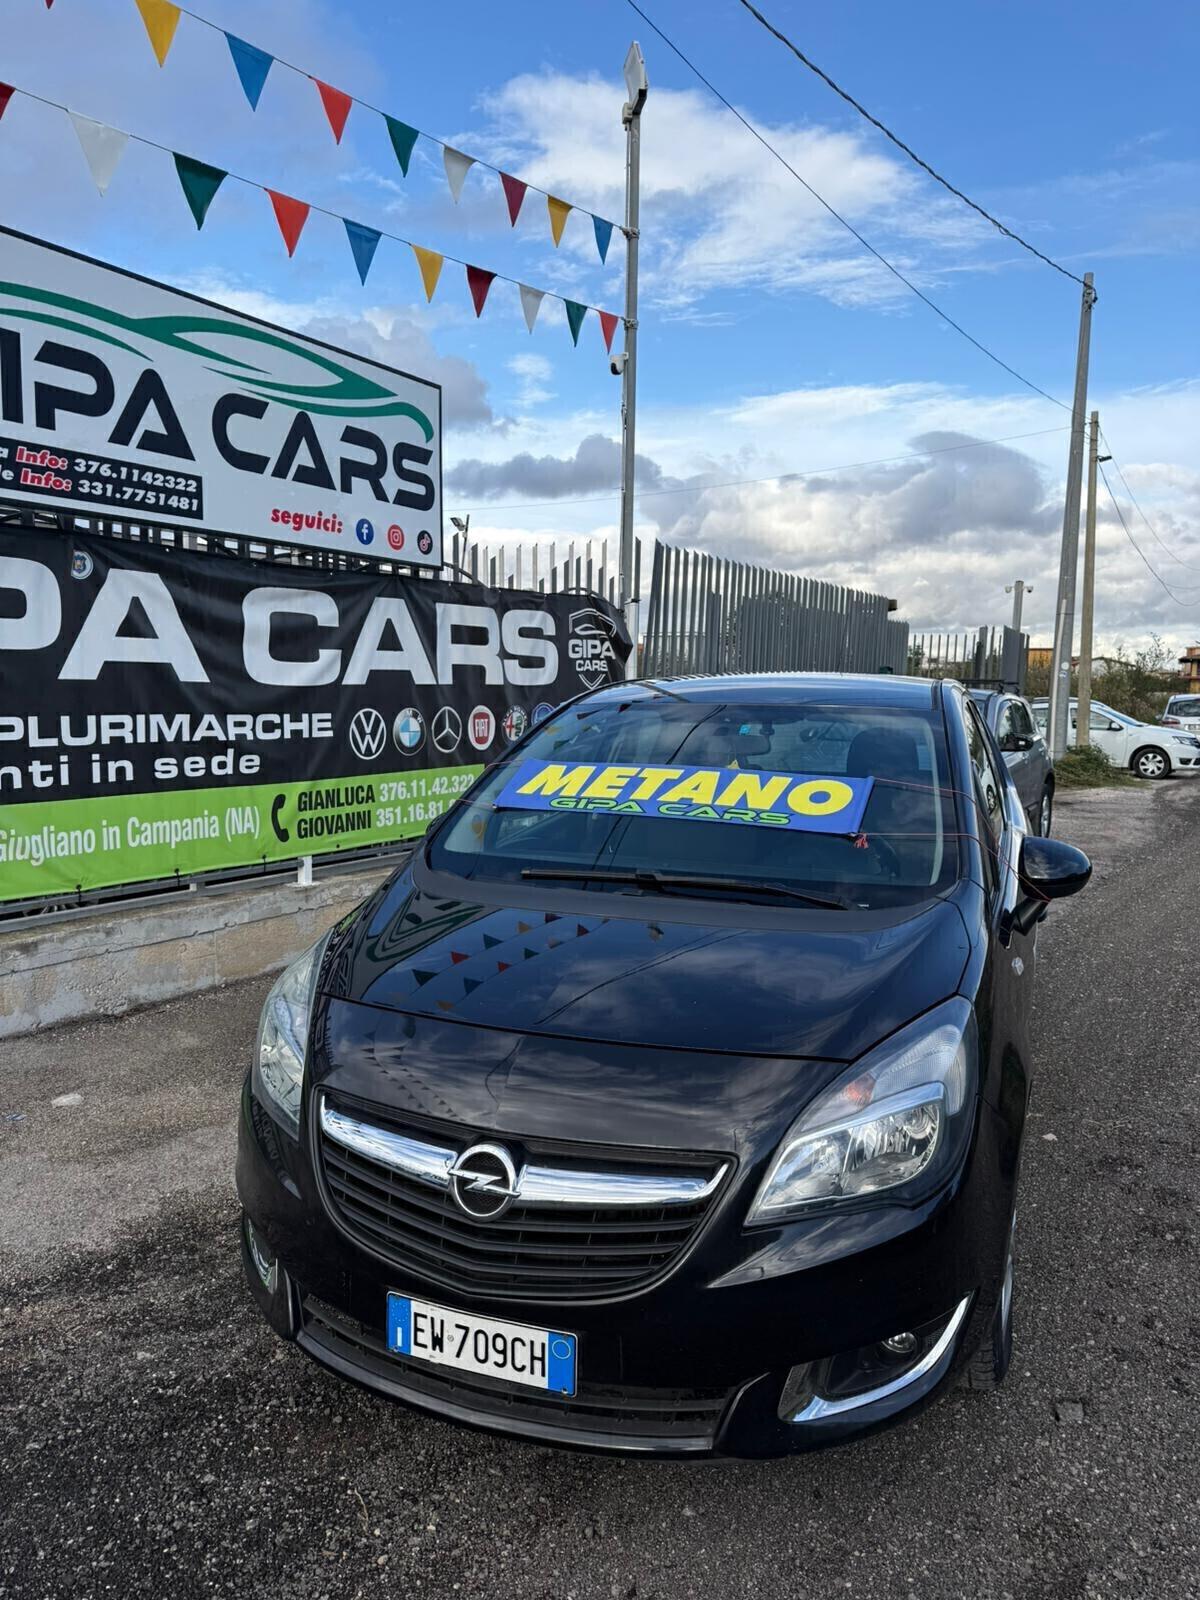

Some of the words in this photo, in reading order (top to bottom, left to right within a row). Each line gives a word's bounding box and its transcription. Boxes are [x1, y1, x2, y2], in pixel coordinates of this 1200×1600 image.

[16, 446, 68, 470] Info:
[73, 458, 198, 493] 376.1142322
[212, 393, 436, 511] CARS
[20, 468, 73, 492] Info:
[77, 479, 199, 511] 331.7751481
[270, 508, 343, 534] seguici:
[242, 587, 558, 687] CARS
[568, 638, 616, 660] GIPA
[575, 659, 609, 672] CARS
[0, 712, 334, 748] PLURIMARCHE
[91, 753, 134, 784] in
[153, 748, 261, 780] sede
[297, 784, 376, 812] GIANLUCA
[516, 764, 853, 816] METANO
[101, 820, 121, 851] in
[127, 810, 220, 849] Campania
[225, 806, 260, 842] (NA)
[297, 810, 372, 839] GIOVANNI
[549, 797, 646, 814] GIPA
[657, 803, 796, 826] CARS
